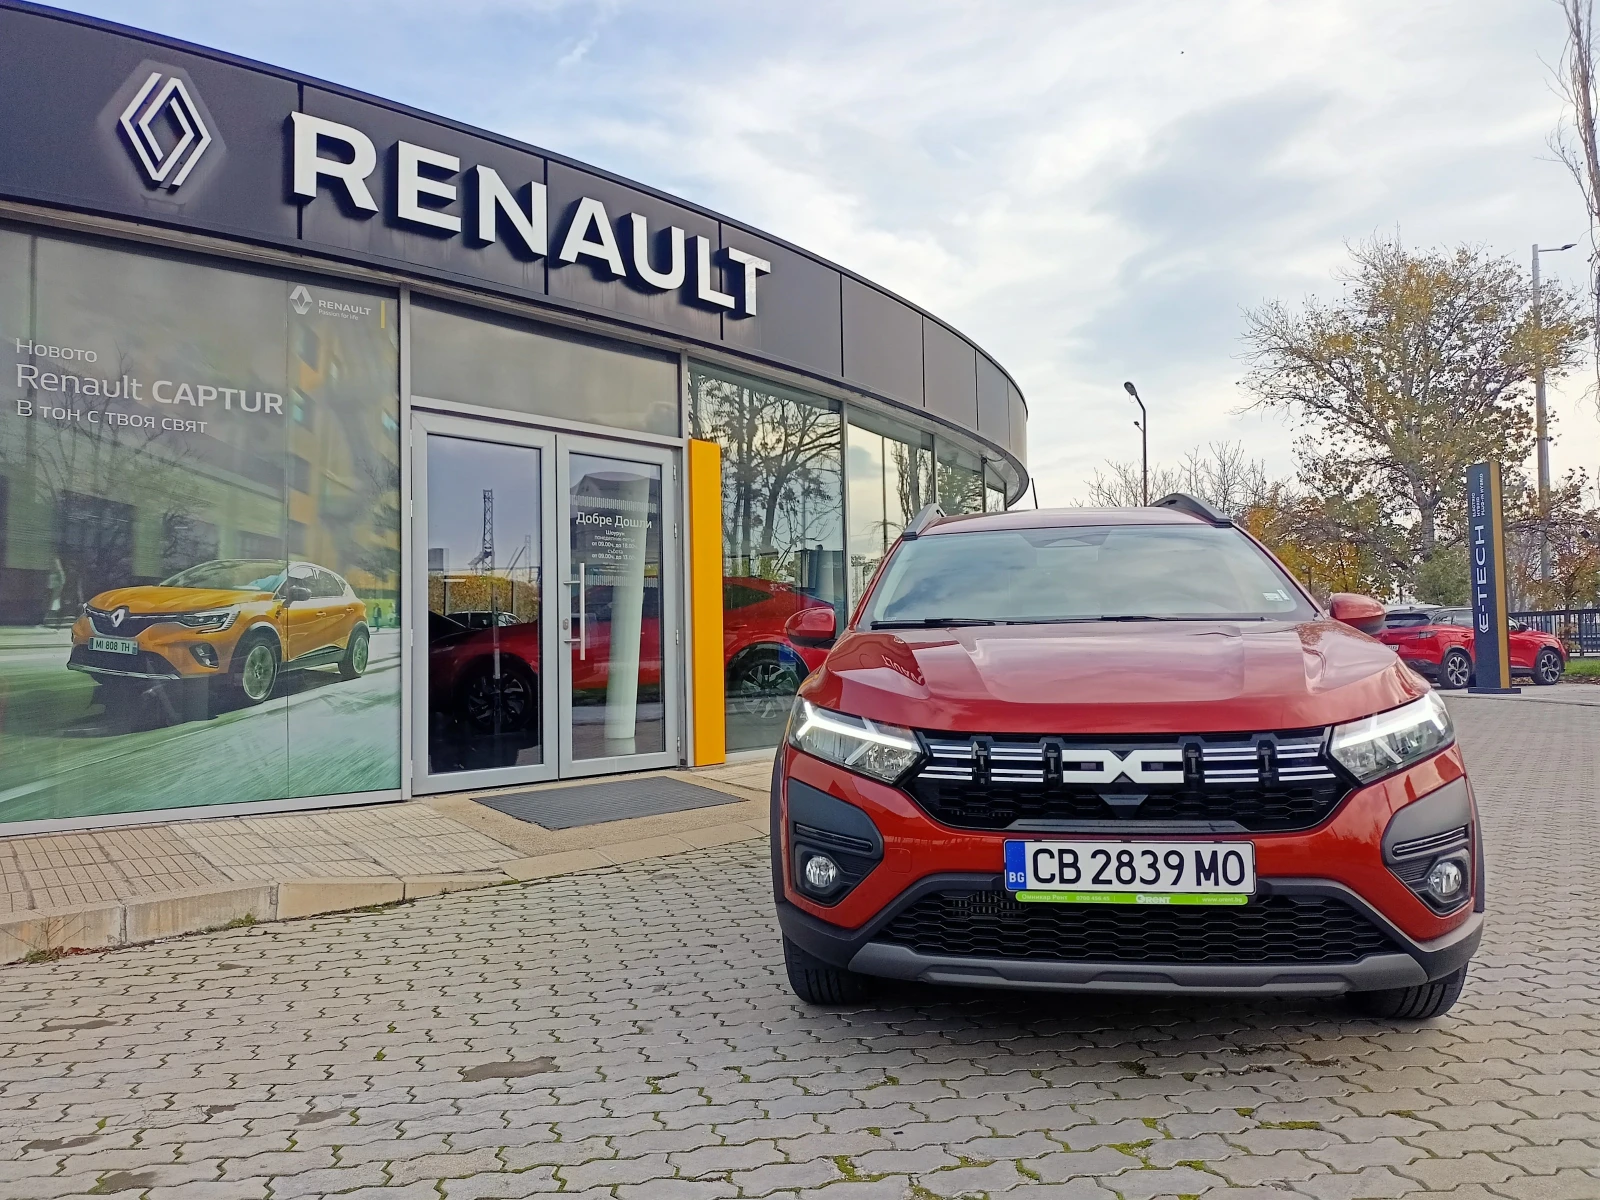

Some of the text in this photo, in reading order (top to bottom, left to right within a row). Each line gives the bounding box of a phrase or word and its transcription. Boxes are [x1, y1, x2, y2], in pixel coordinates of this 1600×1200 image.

[290, 111, 771, 317] RENAULT
[318, 300, 371, 315] RENAULT
[318, 309, 340, 317] Passion
[15, 338, 97, 362] Новото
[16, 363, 283, 415] Renault CAPTUR
[16, 399, 208, 433] В тон с твоя свят
[576, 512, 652, 528] Добре Дошли
[1474, 525, 1489, 633] E-TECH
[96, 640, 130, 652] MI 808 TH
[1032, 848, 1246, 887] CB 2839 MO
[1009, 872, 1025, 883] BG
[1021, 893, 1051, 901] Омникар
[1202, 896, 1243, 904] www.orent.bg
